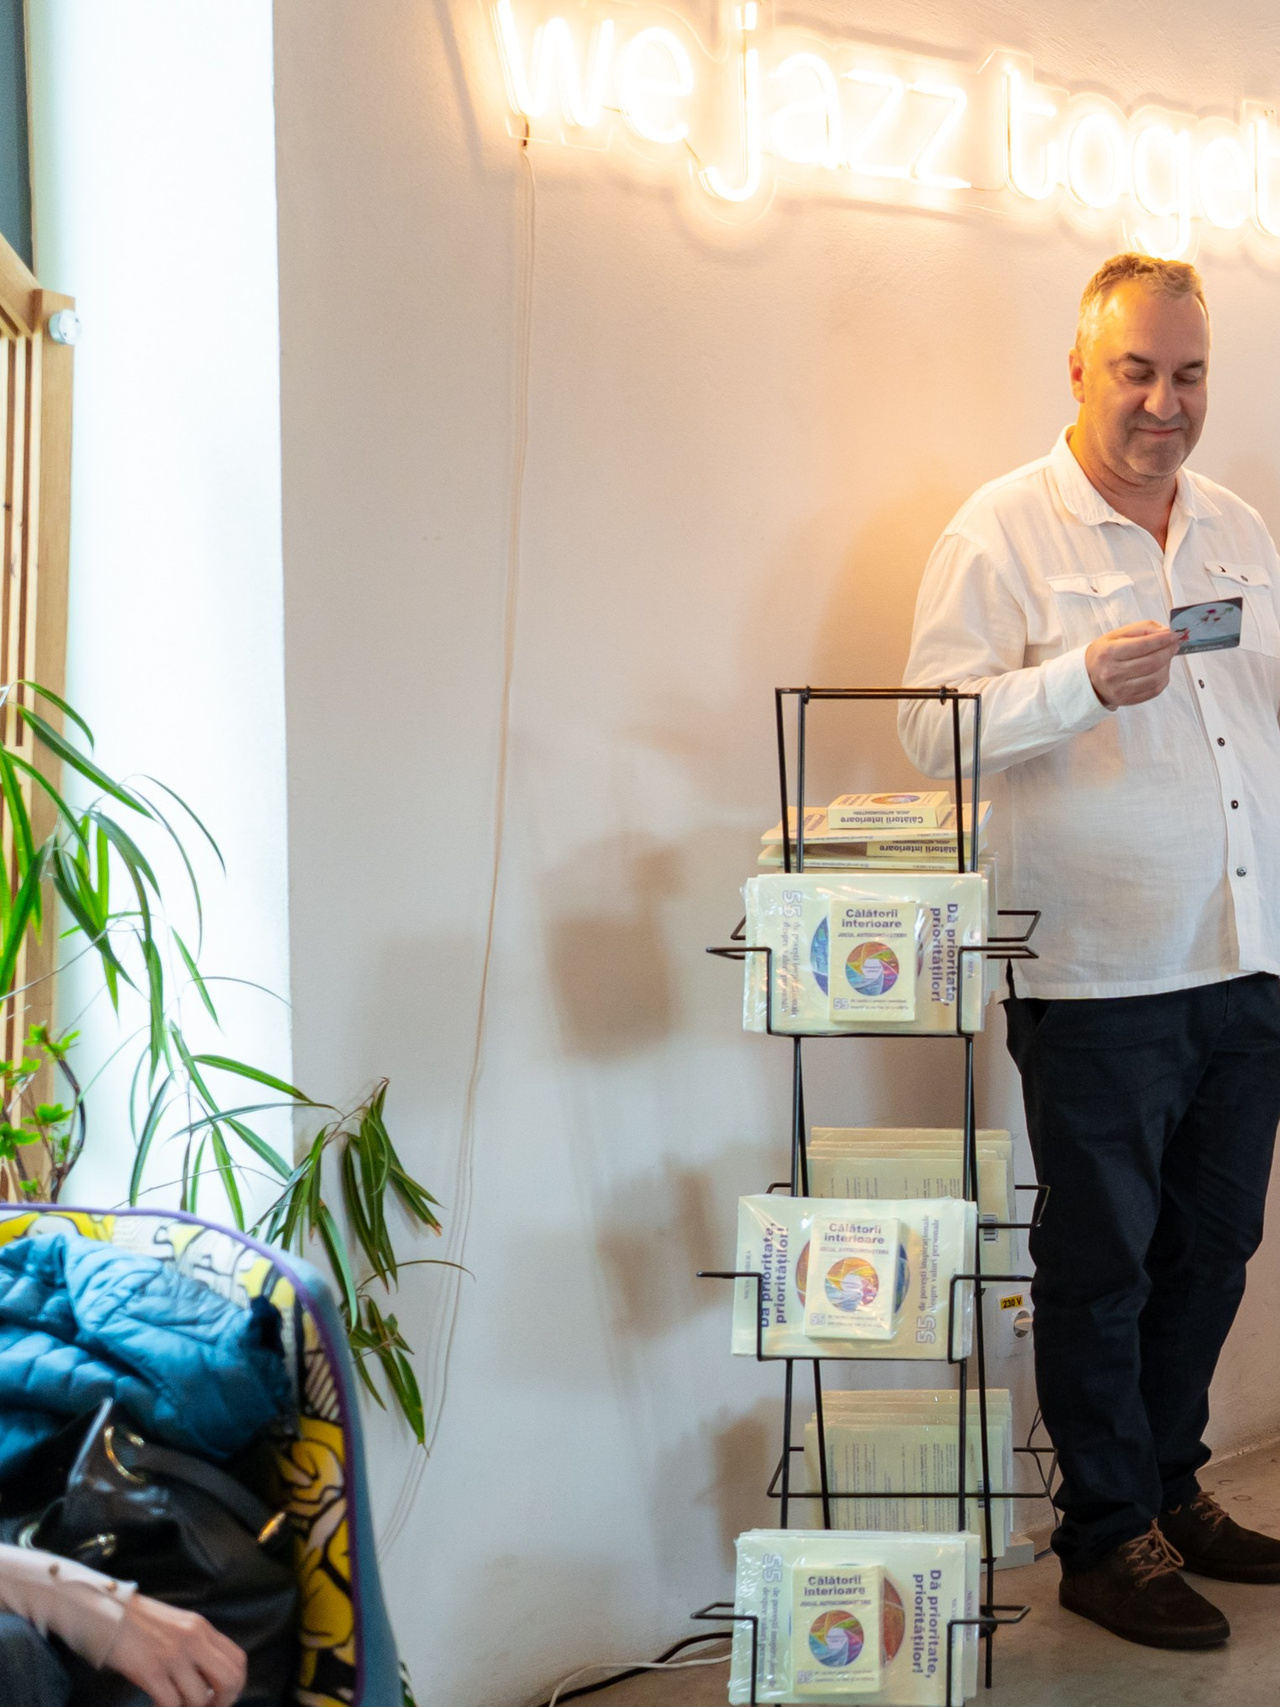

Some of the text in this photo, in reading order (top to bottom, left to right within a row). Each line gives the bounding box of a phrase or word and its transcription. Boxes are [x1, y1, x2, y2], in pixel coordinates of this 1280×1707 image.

[493, 0, 694, 144] we
[697, 0, 971, 201] jazz
[879, 844, 958, 853] ălătorii interioare
[846, 909, 898, 918] Călătorii
[842, 919, 902, 928] interioare
[824, 1233, 885, 1245] interioare
[1003, 1296, 1022, 1308] 230 V
[916, 1314, 936, 1343] 55
[763, 1554, 782, 1583] 55
[804, 1585, 865, 1596] interioare
[926, 1596, 941, 1679] prioritate,
